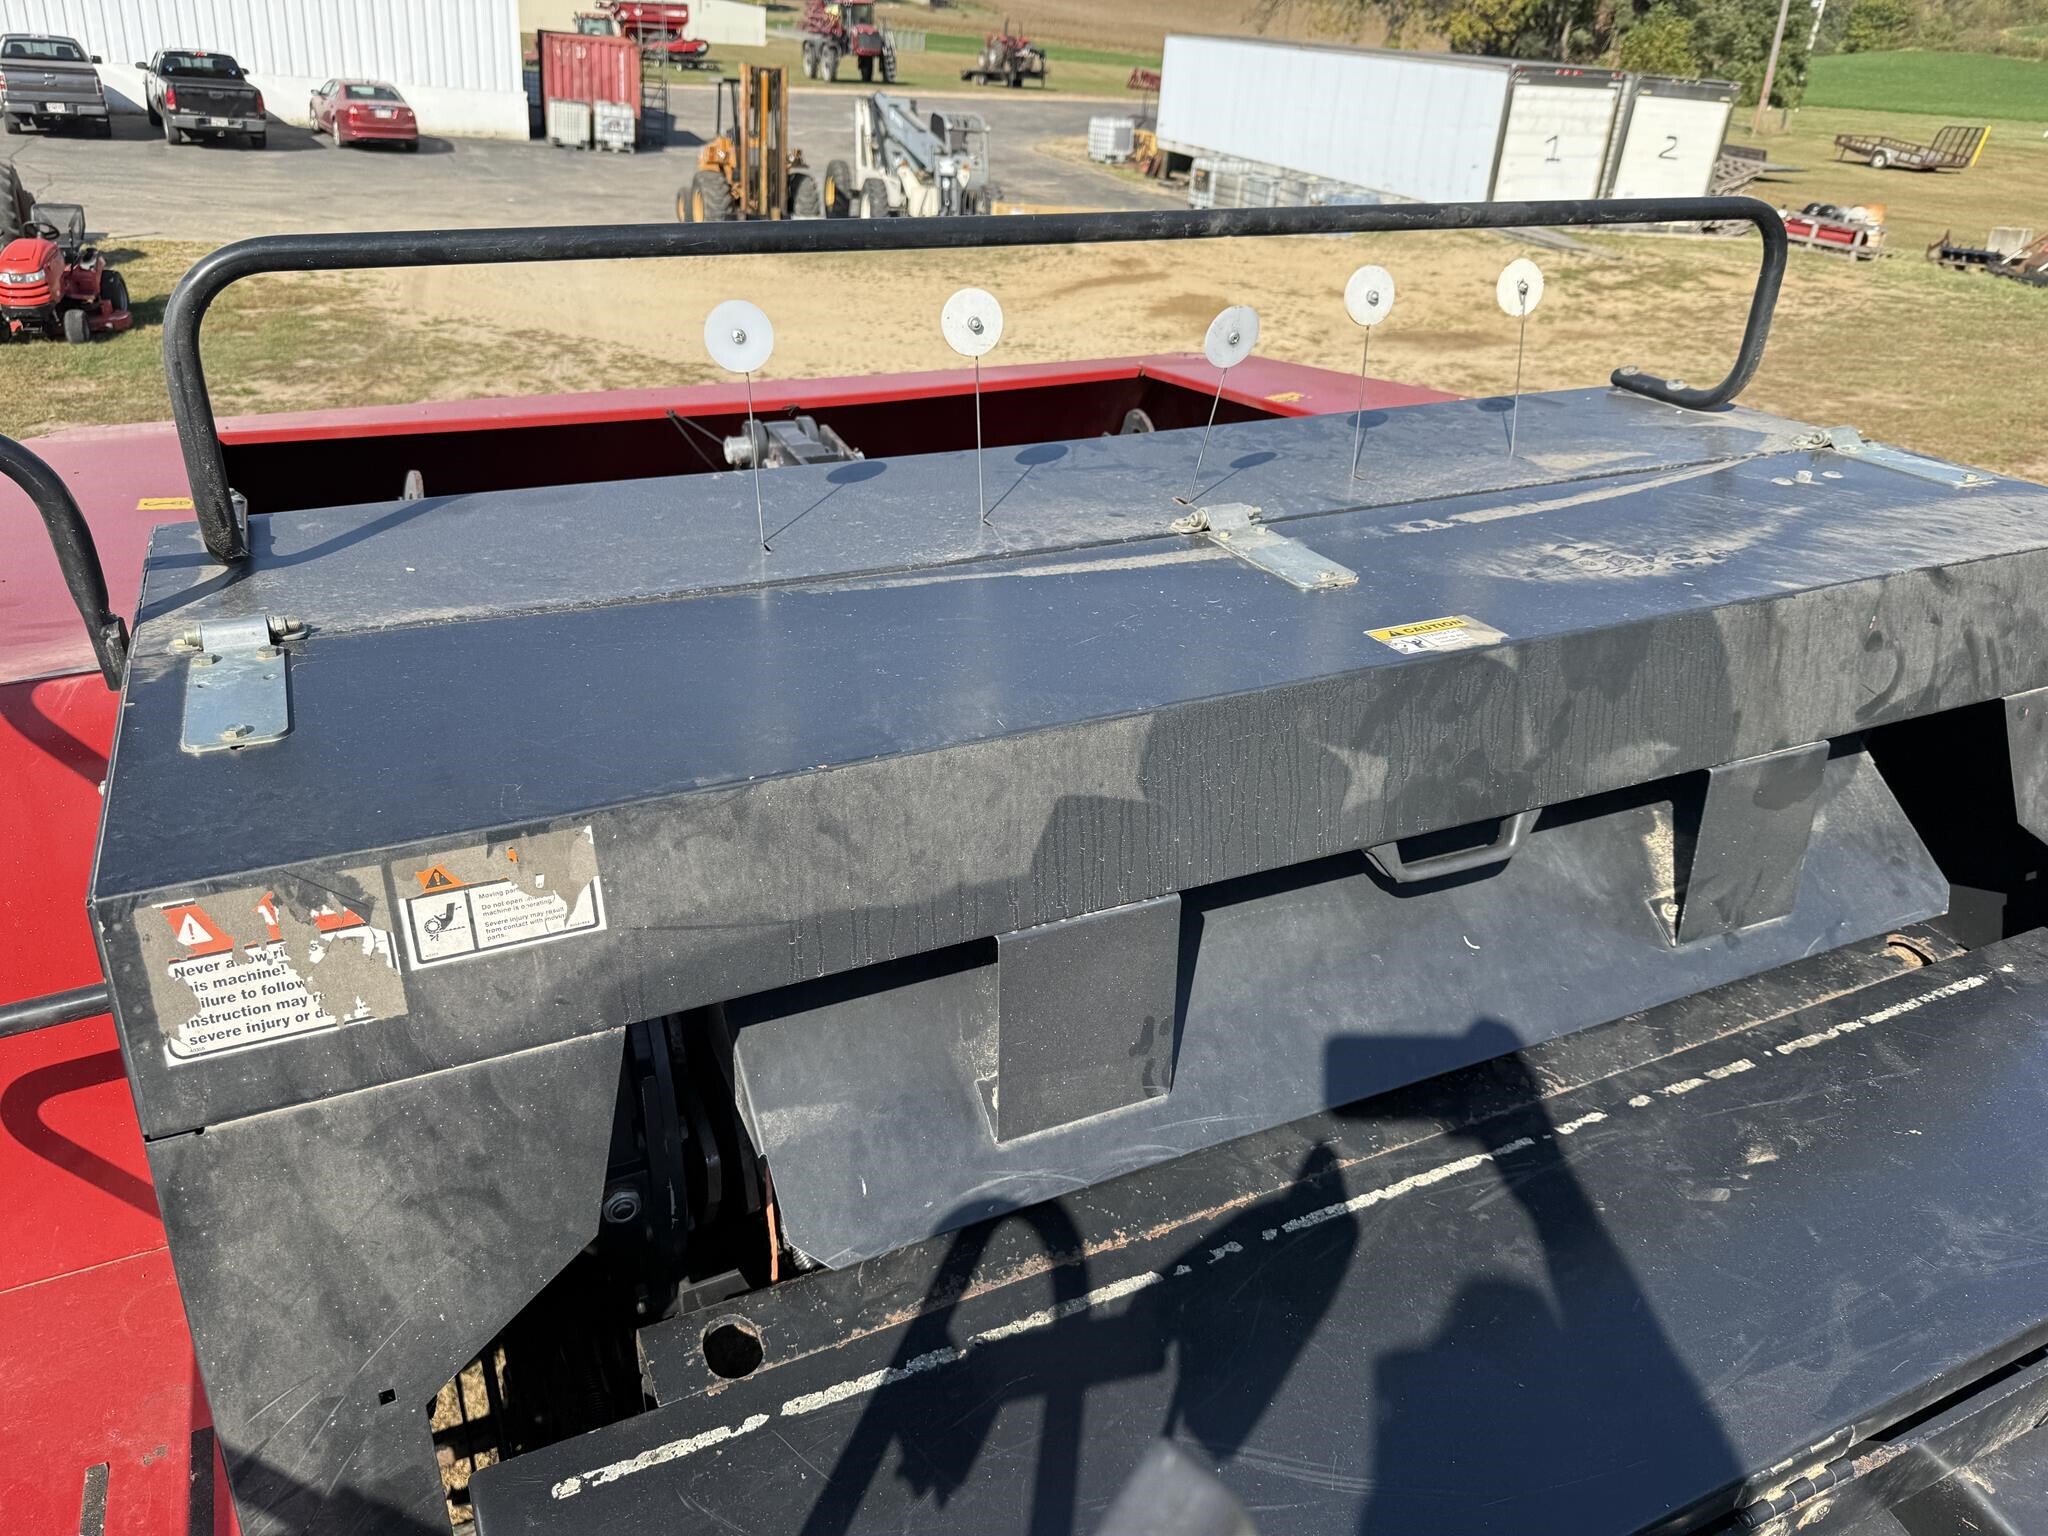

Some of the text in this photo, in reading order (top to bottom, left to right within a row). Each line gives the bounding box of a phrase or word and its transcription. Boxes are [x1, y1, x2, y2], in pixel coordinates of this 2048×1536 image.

[1545, 135, 1560, 162] 1
[1658, 135, 1678, 160] 2
[1403, 619, 1463, 633] CAUTION
[478, 890, 504, 899] Moving
[506, 898, 523, 906] open
[483, 907, 512, 917] machine
[485, 918, 508, 928] Severe
[510, 914, 529, 923] injury
[530, 911, 544, 919] may
[486, 913, 566, 935] from contact with movin
[174, 961, 220, 979] Never
[213, 964, 286, 989] machine!
[241, 989, 257, 1000] to
[262, 979, 305, 997] follow
[276, 995, 308, 1011] may
[190, 1027, 242, 1046] severe
[246, 1016, 290, 1034] injury
[295, 1012, 310, 1023] or
